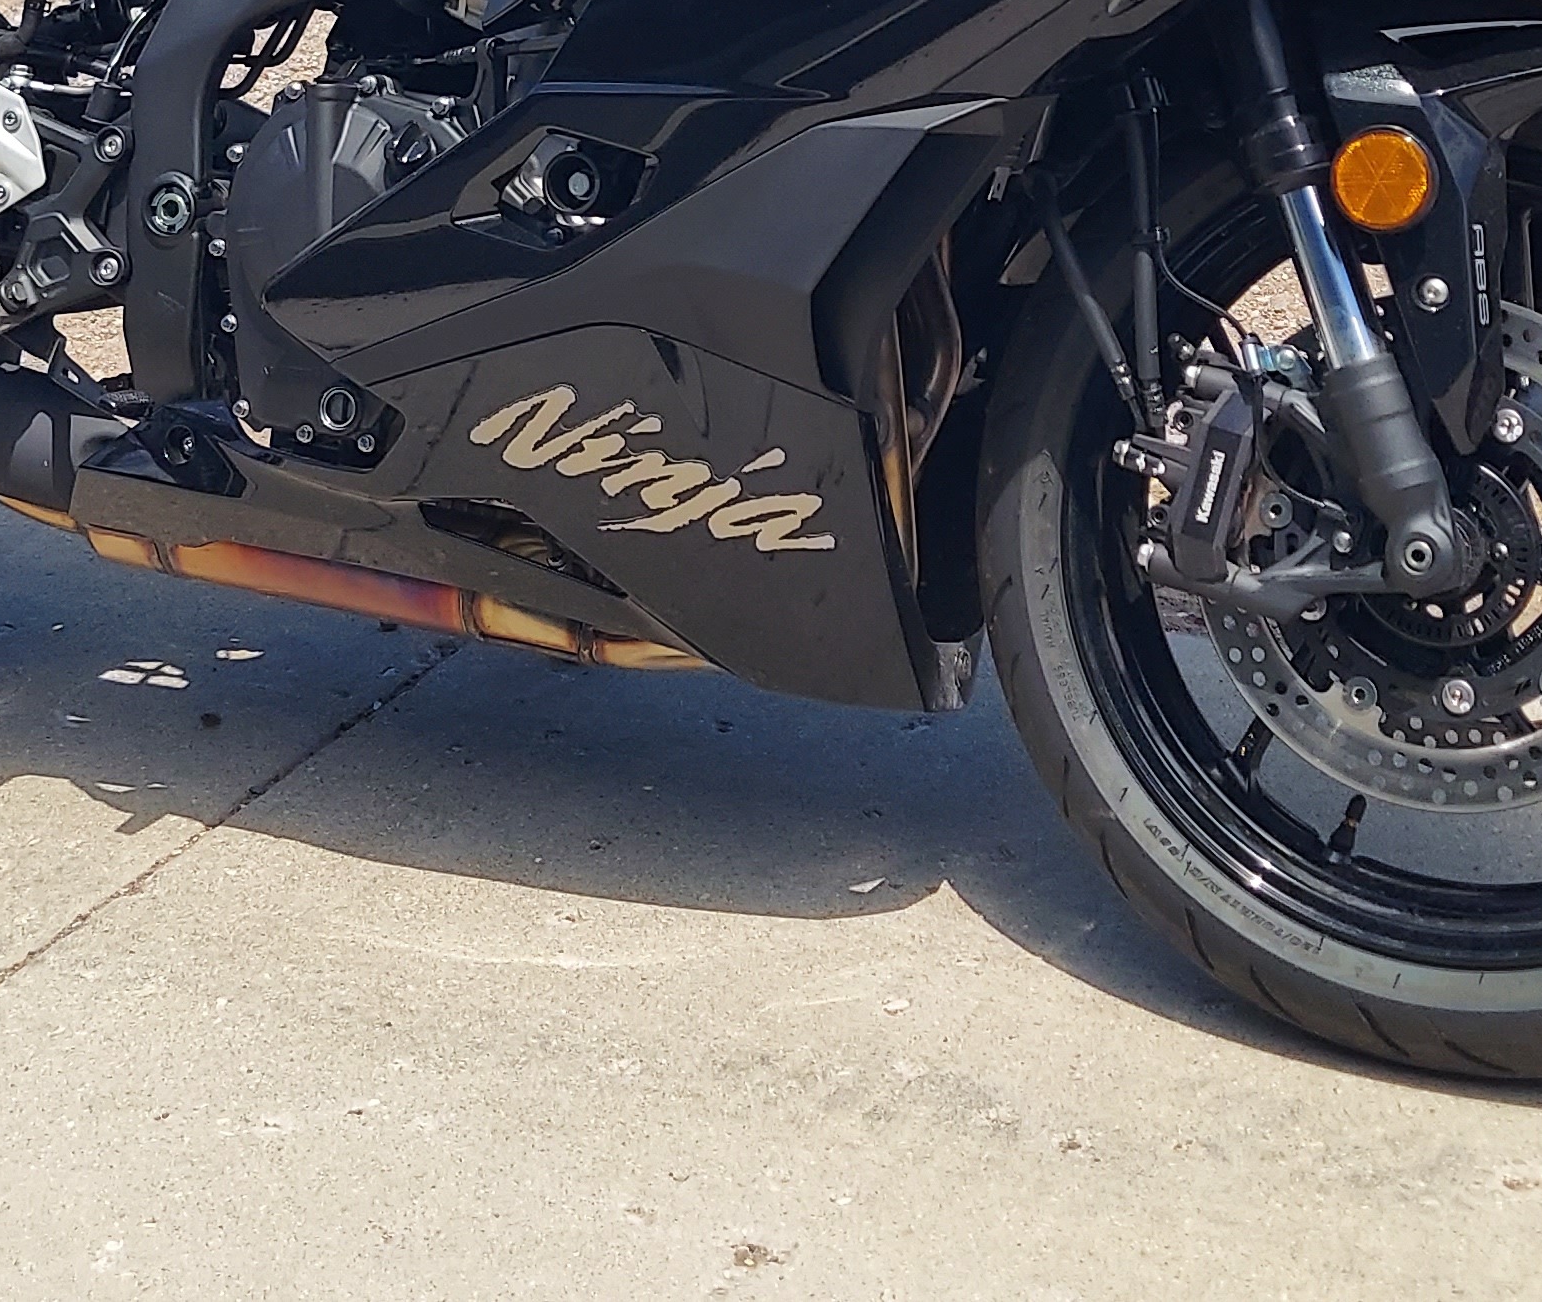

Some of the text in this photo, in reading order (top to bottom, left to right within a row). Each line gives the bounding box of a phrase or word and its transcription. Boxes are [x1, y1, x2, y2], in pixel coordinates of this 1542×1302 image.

[1472, 223, 1490, 327] ABS
[469, 383, 837, 552] Ninja
[1195, 449, 1226, 524] Kawasaki
